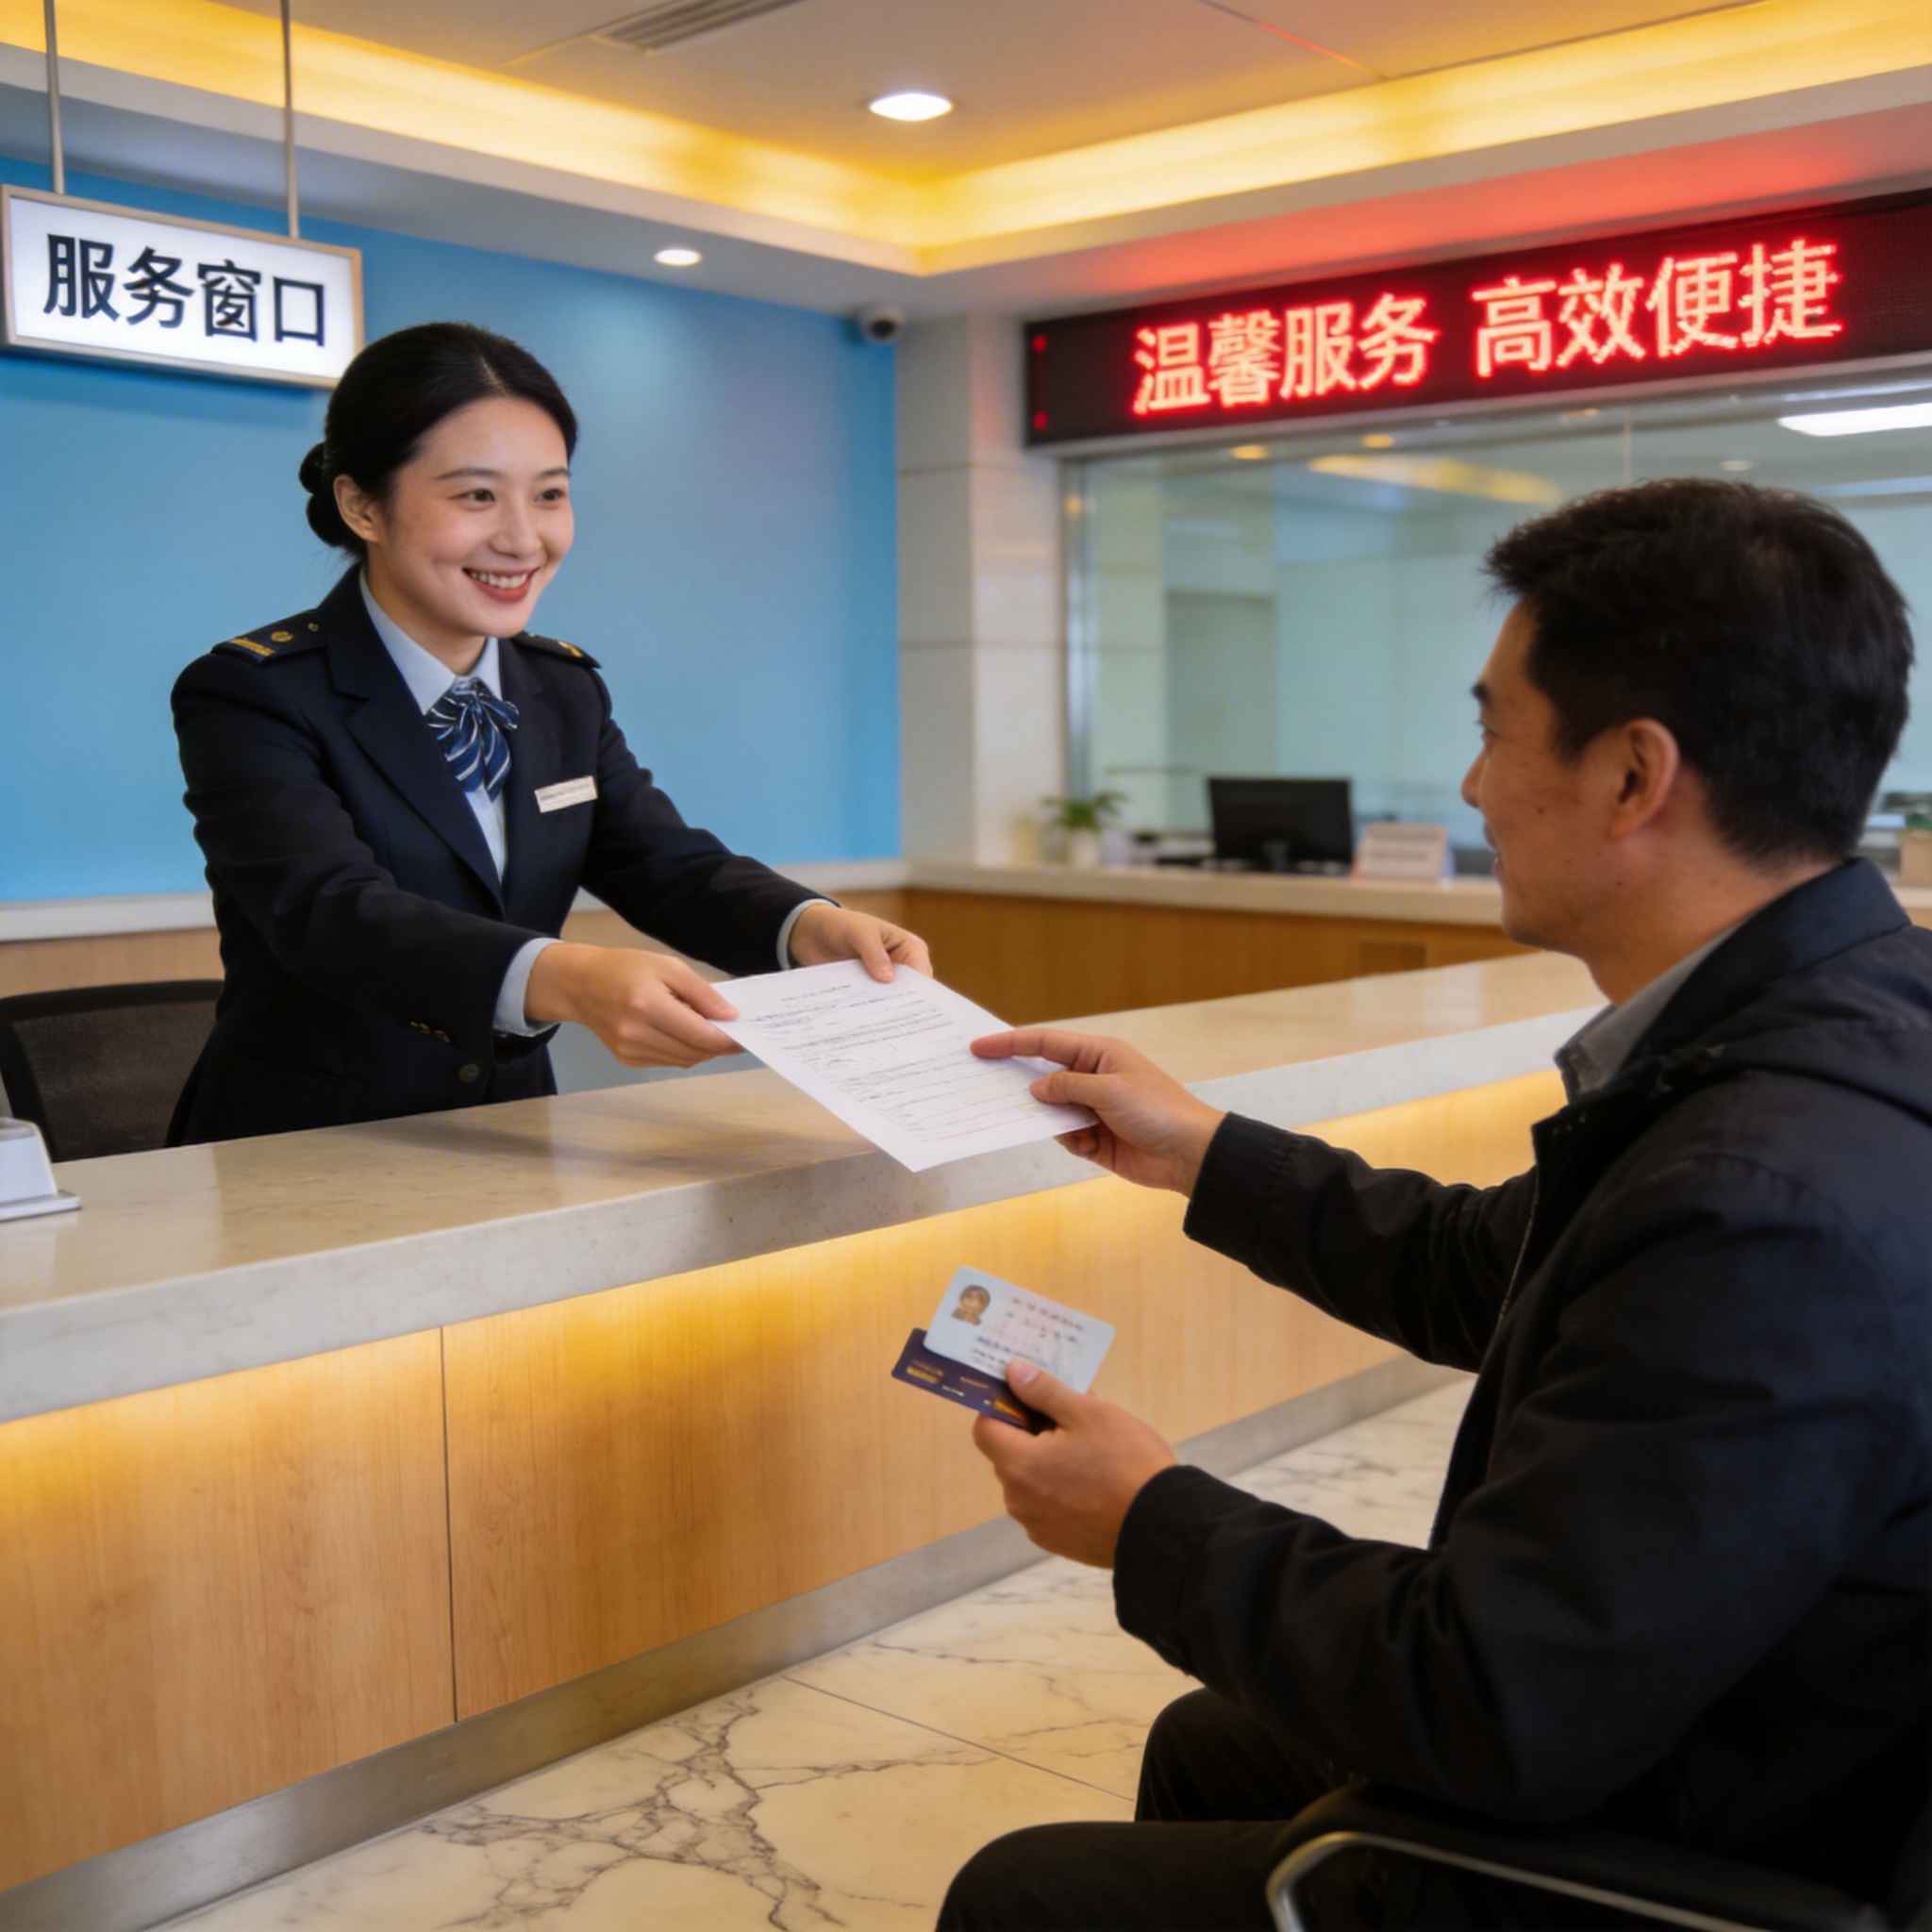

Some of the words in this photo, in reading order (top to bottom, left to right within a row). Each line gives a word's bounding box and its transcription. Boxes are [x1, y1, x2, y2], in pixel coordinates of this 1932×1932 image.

[43, 233, 325, 346] 服务窗口
[1134, 293, 1437, 414] 温馨服务
[1471, 239, 1842, 377] 高效便捷
